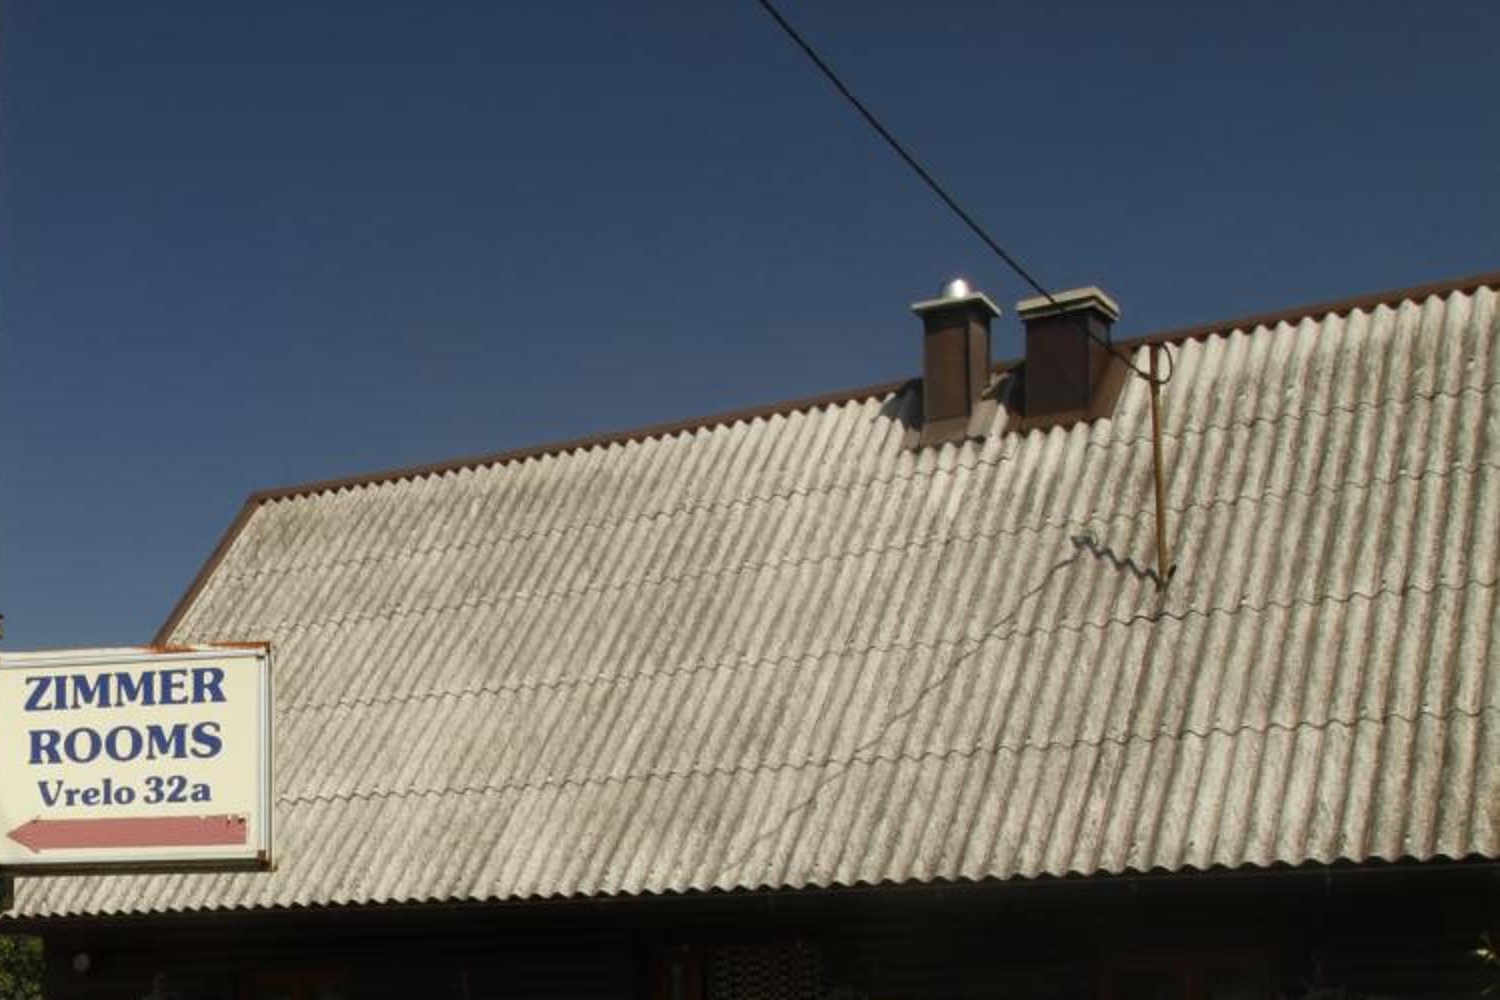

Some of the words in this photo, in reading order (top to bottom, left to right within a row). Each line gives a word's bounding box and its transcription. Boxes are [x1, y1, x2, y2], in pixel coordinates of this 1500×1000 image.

[24, 667, 226, 711] ZIMMER
[28, 721, 223, 764] ROOMS
[37, 778, 136, 806] Vrelo
[144, 775, 212, 804] 32a
